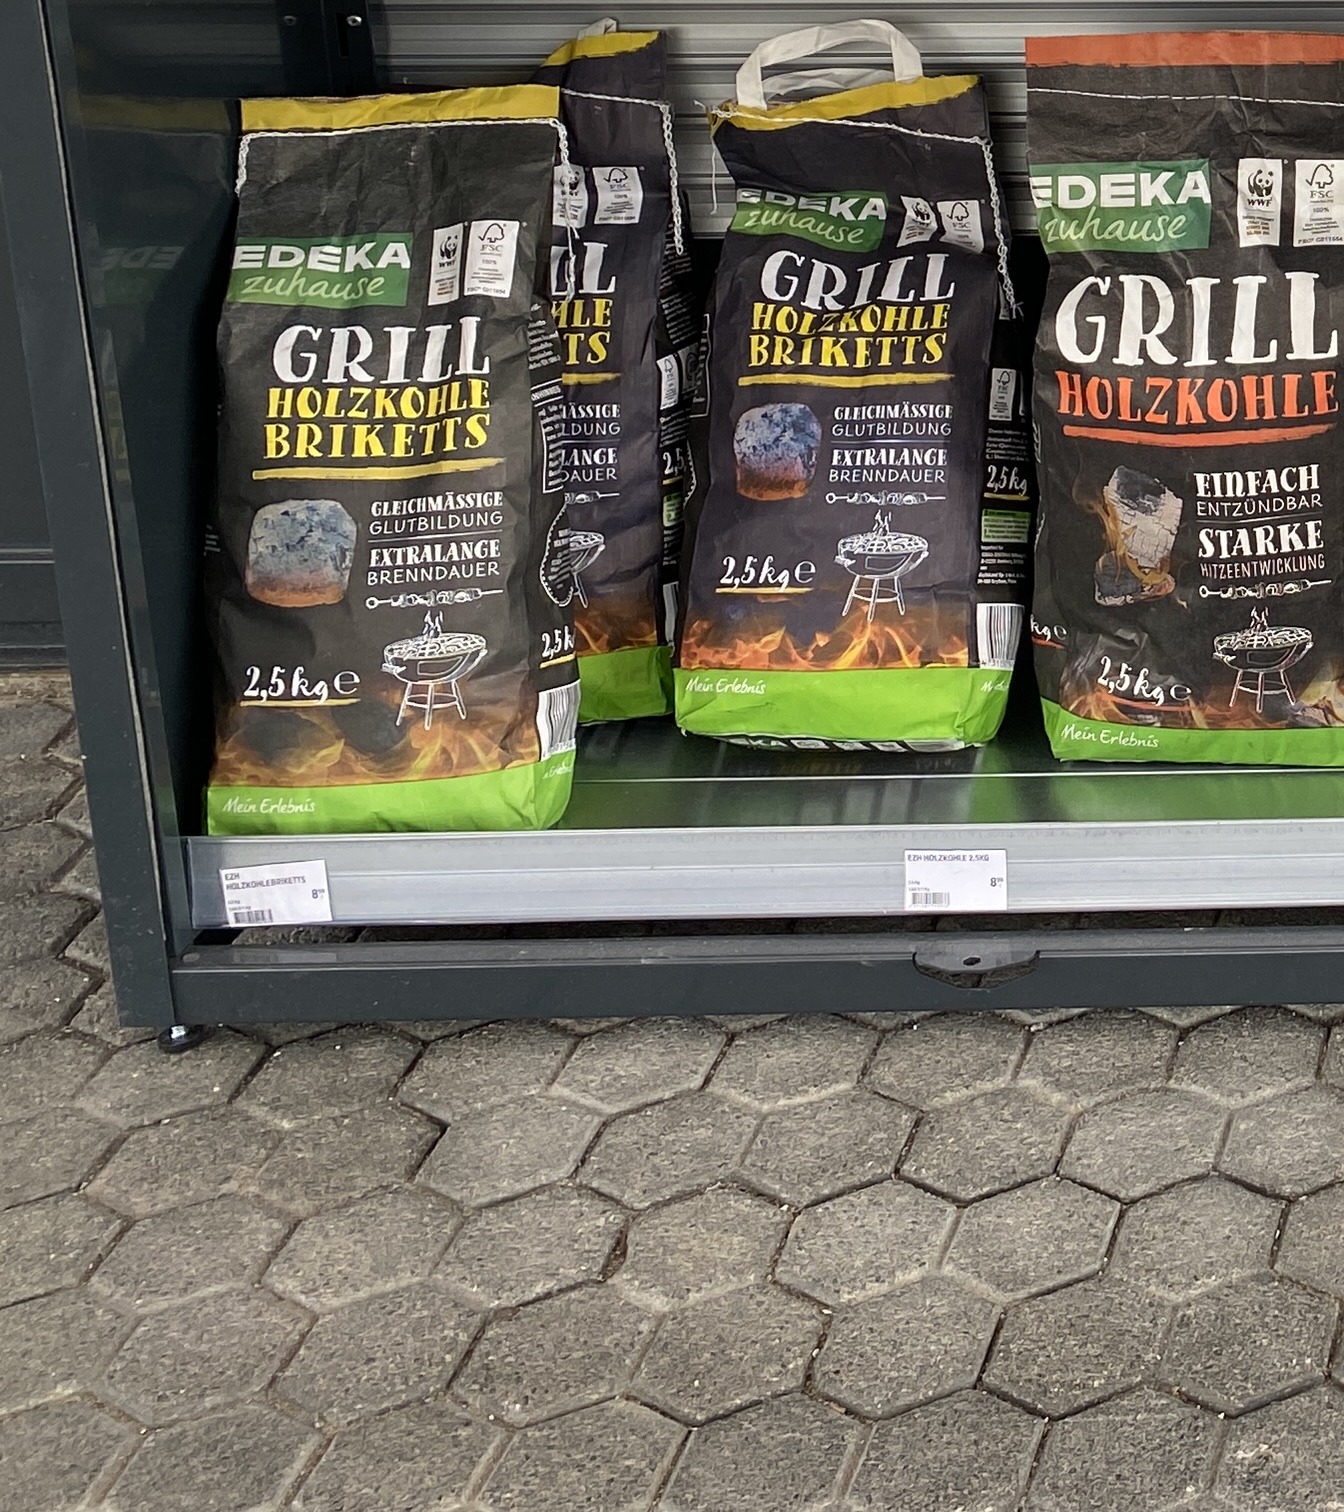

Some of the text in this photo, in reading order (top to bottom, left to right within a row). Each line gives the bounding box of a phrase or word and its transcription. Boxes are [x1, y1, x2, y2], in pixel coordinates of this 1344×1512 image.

[736, 188, 888, 221] EDEKA
[1030, 170, 1211, 209] EDEKA
[1247, 197, 1273, 207] WWF
[1309, 190, 1334, 200] FSC
[744, 202, 865, 244] zuhause
[1045, 206, 1187, 243] zuhause
[231, 242, 412, 273] EDEKA
[241, 267, 385, 300] zuhause
[760, 249, 955, 311] GRILL
[751, 302, 951, 336] HOLZKOHLE
[1055, 272, 1338, 367] GRILL
[272, 316, 490, 385] GRILL
[748, 333, 948, 369] BRIKETTS
[266, 378, 491, 419] HOLZKOHLE
[834, 401, 953, 421] GLEICHMÄSSIGE
[1055, 370, 1339, 425] HOLZKOHLE
[263, 413, 491, 459] BRIKETTS
[832, 422, 952, 437] GLUTBILDUNG
[832, 448, 947, 466] EXTRALANGE
[829, 469, 945, 484] BRENNDAUER
[1194, 464, 1320, 498] EINFACH
[371, 491, 503, 516] GLEICHMÄSSIGE
[1196, 493, 1323, 517] ENTZÜNDBAR
[369, 510, 503, 536] GLUTBILDUNG
[369, 539, 501, 568] EXTRALANGE
[1199, 520, 1324, 559] STARKE
[367, 561, 500, 586] BRENNDAUER
[1200, 553, 1325, 580] HITZEENTWICKLUNG
[1061, 724, 1159, 749] Mein Erlebnis
[222, 797, 316, 814] Mein Erlebnis
